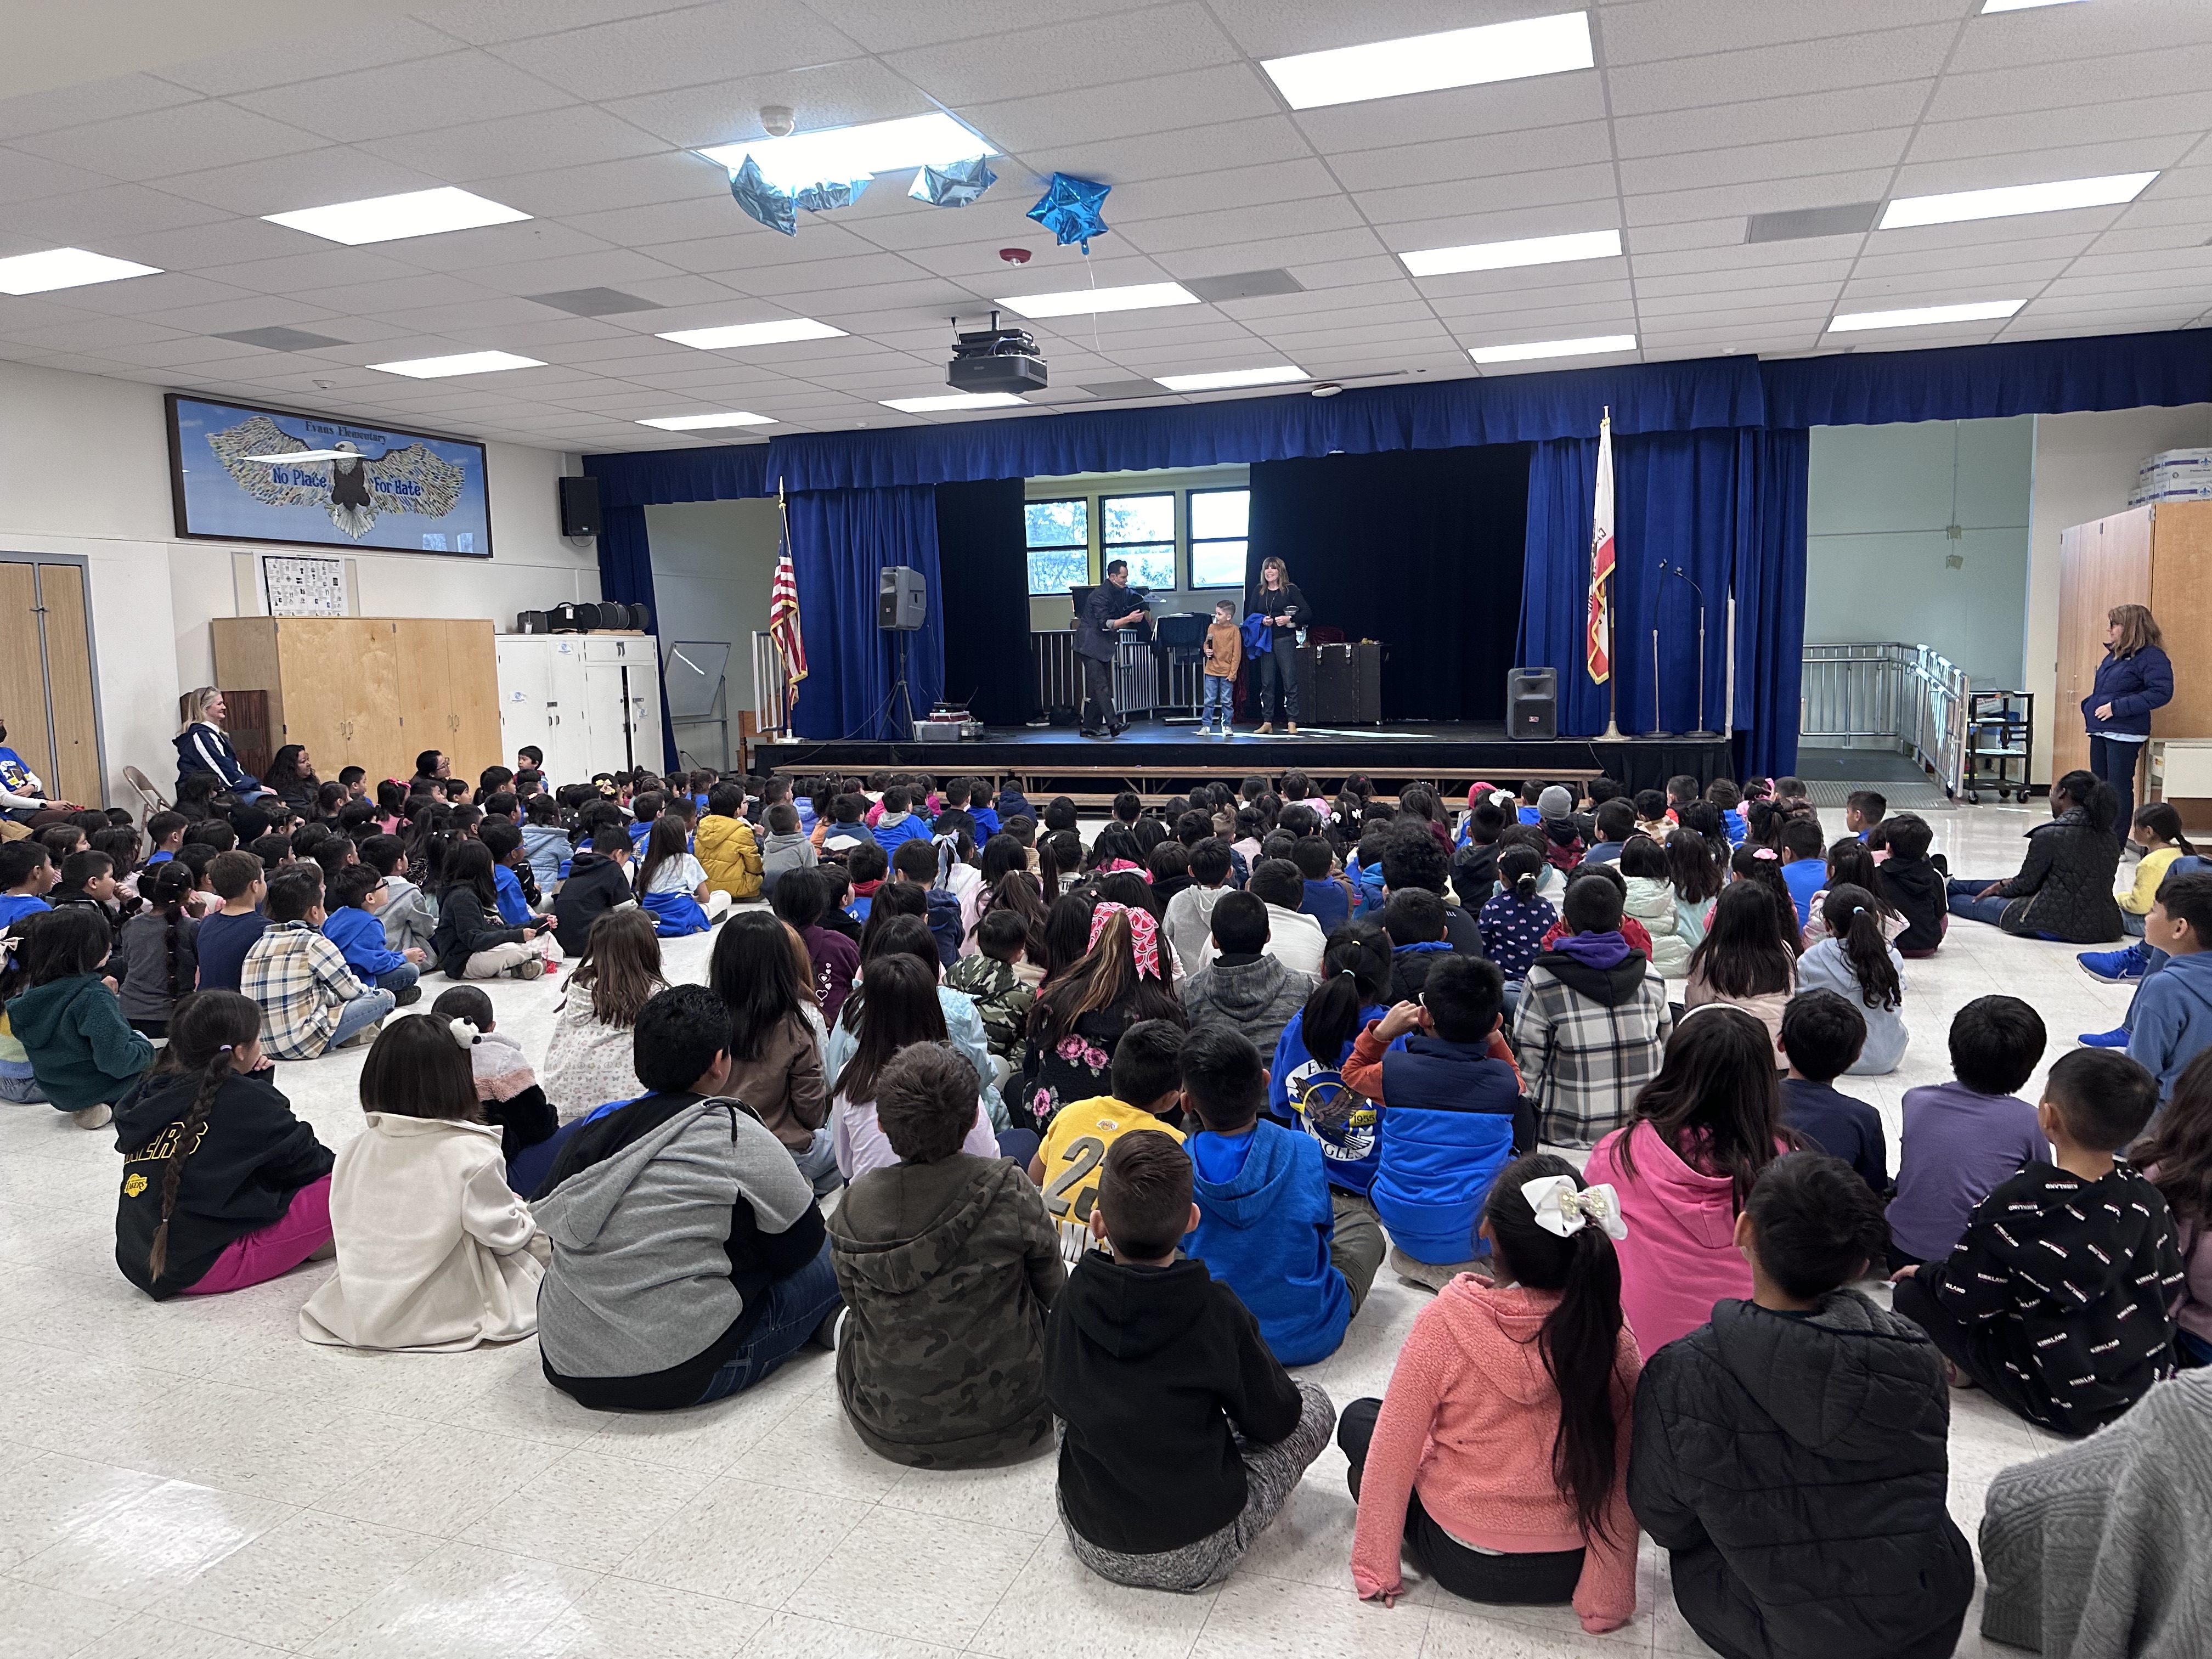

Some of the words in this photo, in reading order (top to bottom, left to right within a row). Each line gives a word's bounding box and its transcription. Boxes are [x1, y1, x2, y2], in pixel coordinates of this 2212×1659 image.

[305, 421, 334, 435] Evans
[338, 426, 386, 445] Elementary
[273, 467, 289, 484] No
[292, 469, 327, 488] Place
[374, 477, 392, 493] For
[394, 479, 421, 496] Hate
[1353, 1114, 1375, 1124] 1955
[1042, 1136, 1104, 1223] 2
[1977, 1272, 2008, 1283] KIRKLAND
[2036, 1332, 2067, 1347] KIRKLAND
[2090, 1339, 2120, 1353] KIRKLAND
